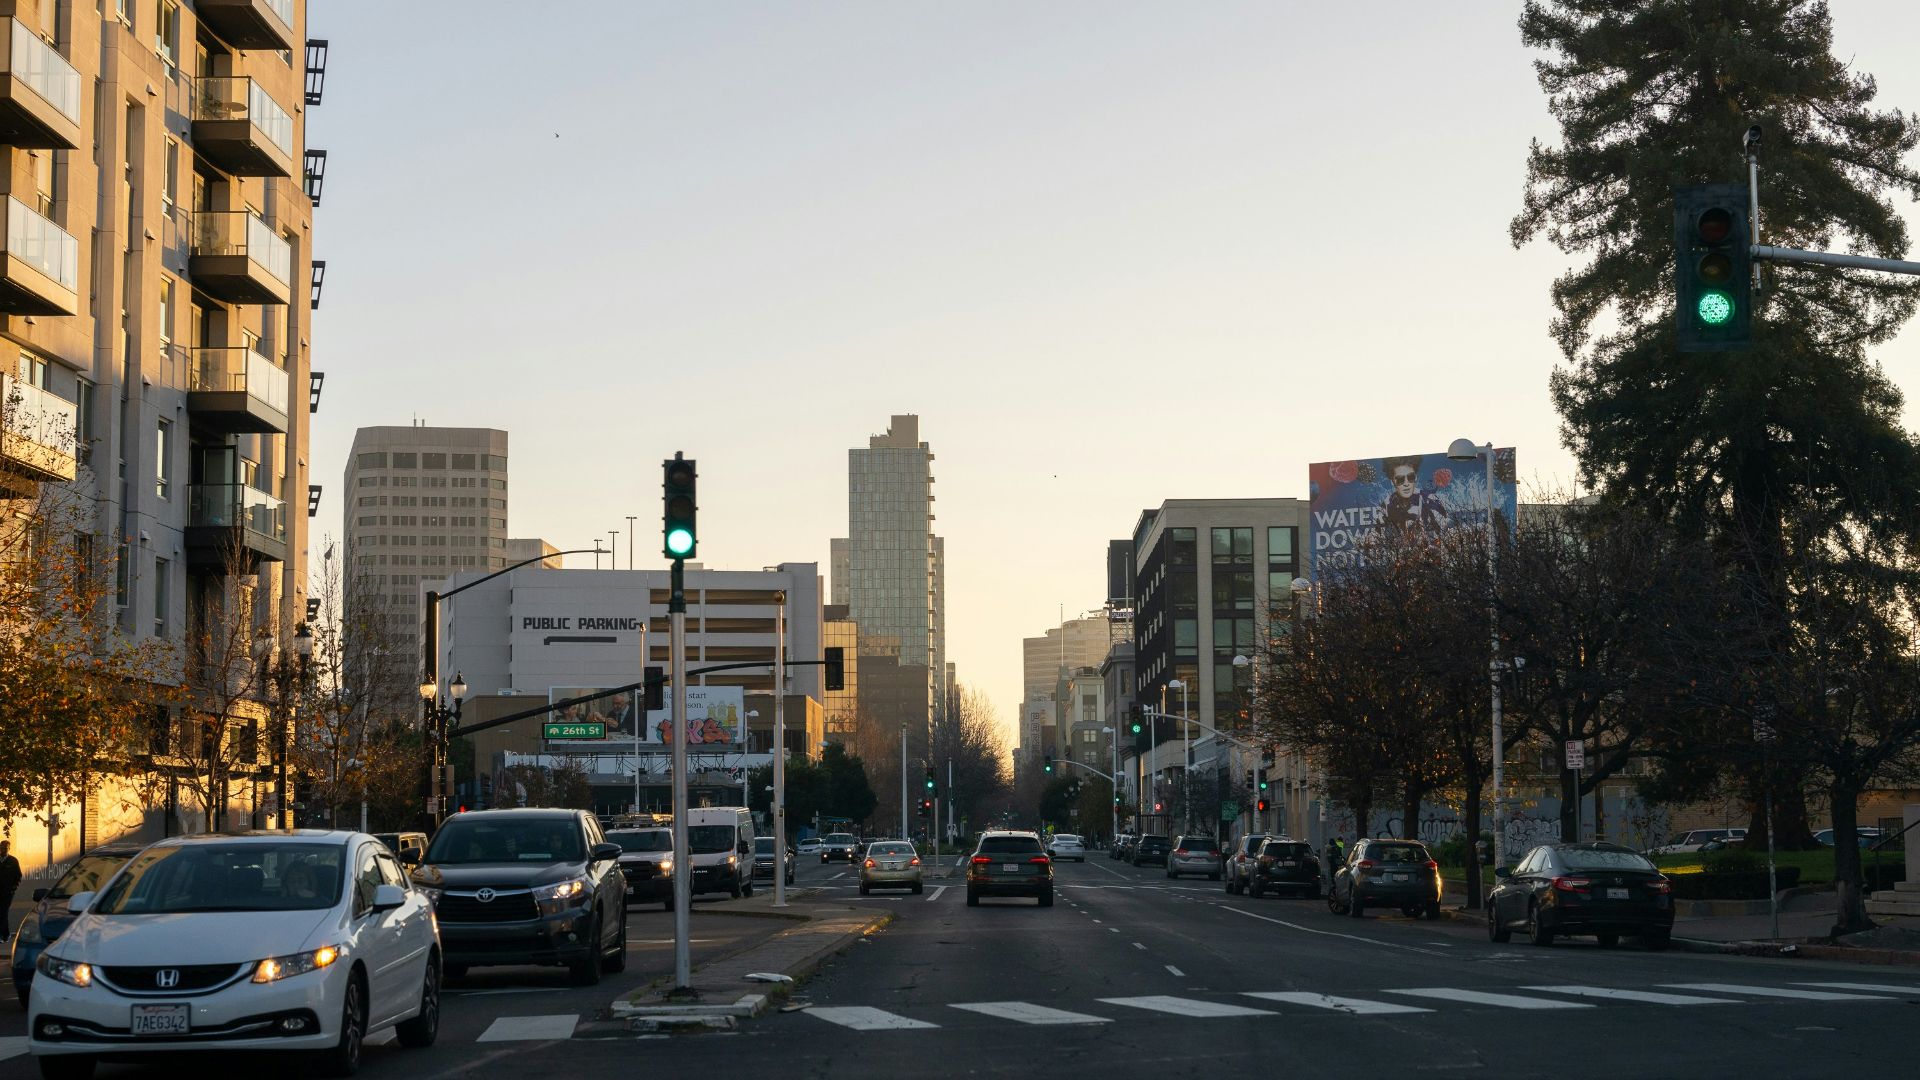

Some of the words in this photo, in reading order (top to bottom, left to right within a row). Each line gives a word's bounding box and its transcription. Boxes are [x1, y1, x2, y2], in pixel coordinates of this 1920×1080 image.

[1314, 506, 1386, 529] WATER
[523, 617, 571, 630] PUBLIC
[578, 617, 637, 630] PARKING
[562, 726, 586, 736] 26th
[588, 726, 600, 736] St
[135, 1015, 186, 1030] 7AEG342
